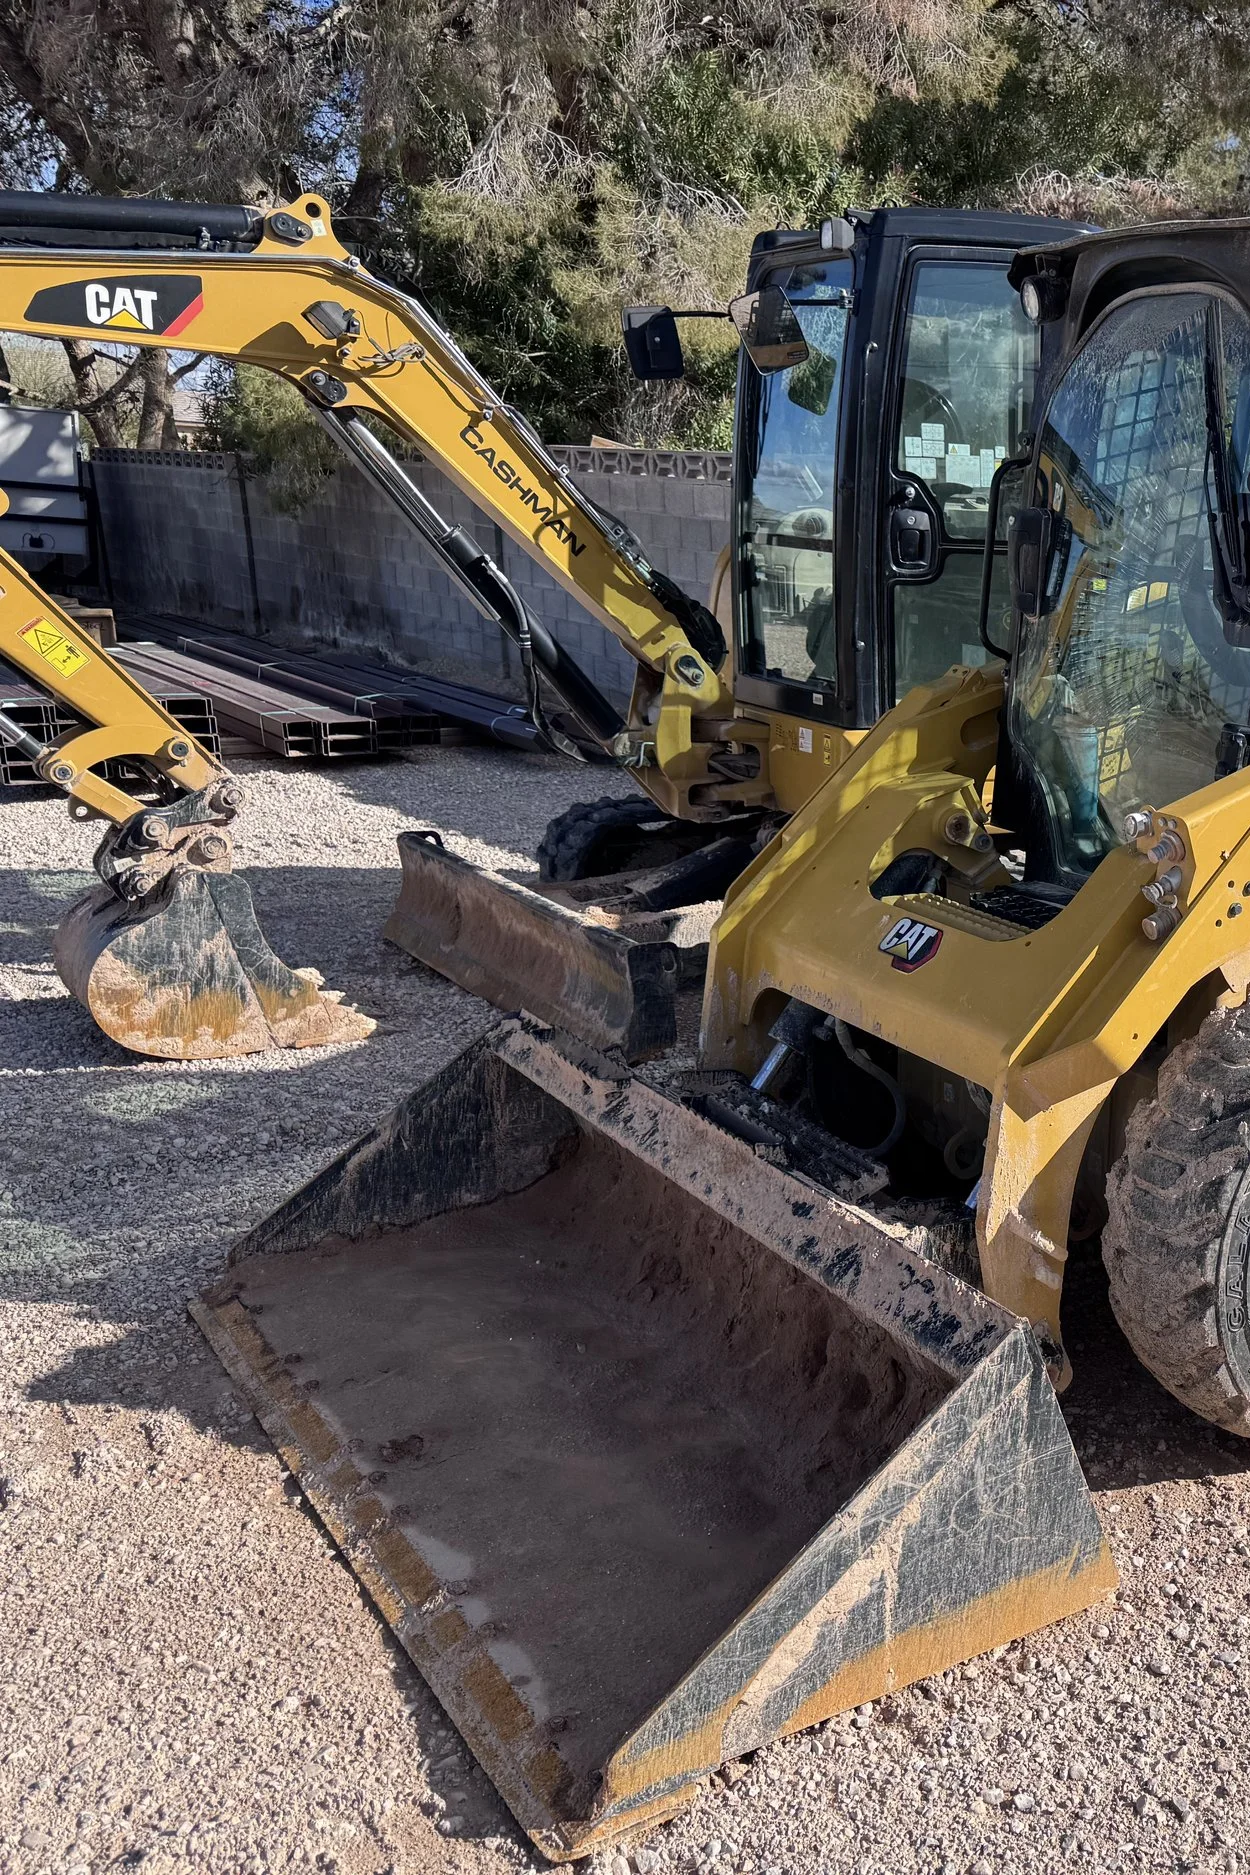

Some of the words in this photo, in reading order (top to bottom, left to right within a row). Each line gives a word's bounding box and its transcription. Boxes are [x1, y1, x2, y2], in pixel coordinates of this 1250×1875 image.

[85, 283, 158, 330] CAT
[459, 426, 587, 557] CASHMAN
[880, 918, 939, 961] CAT
